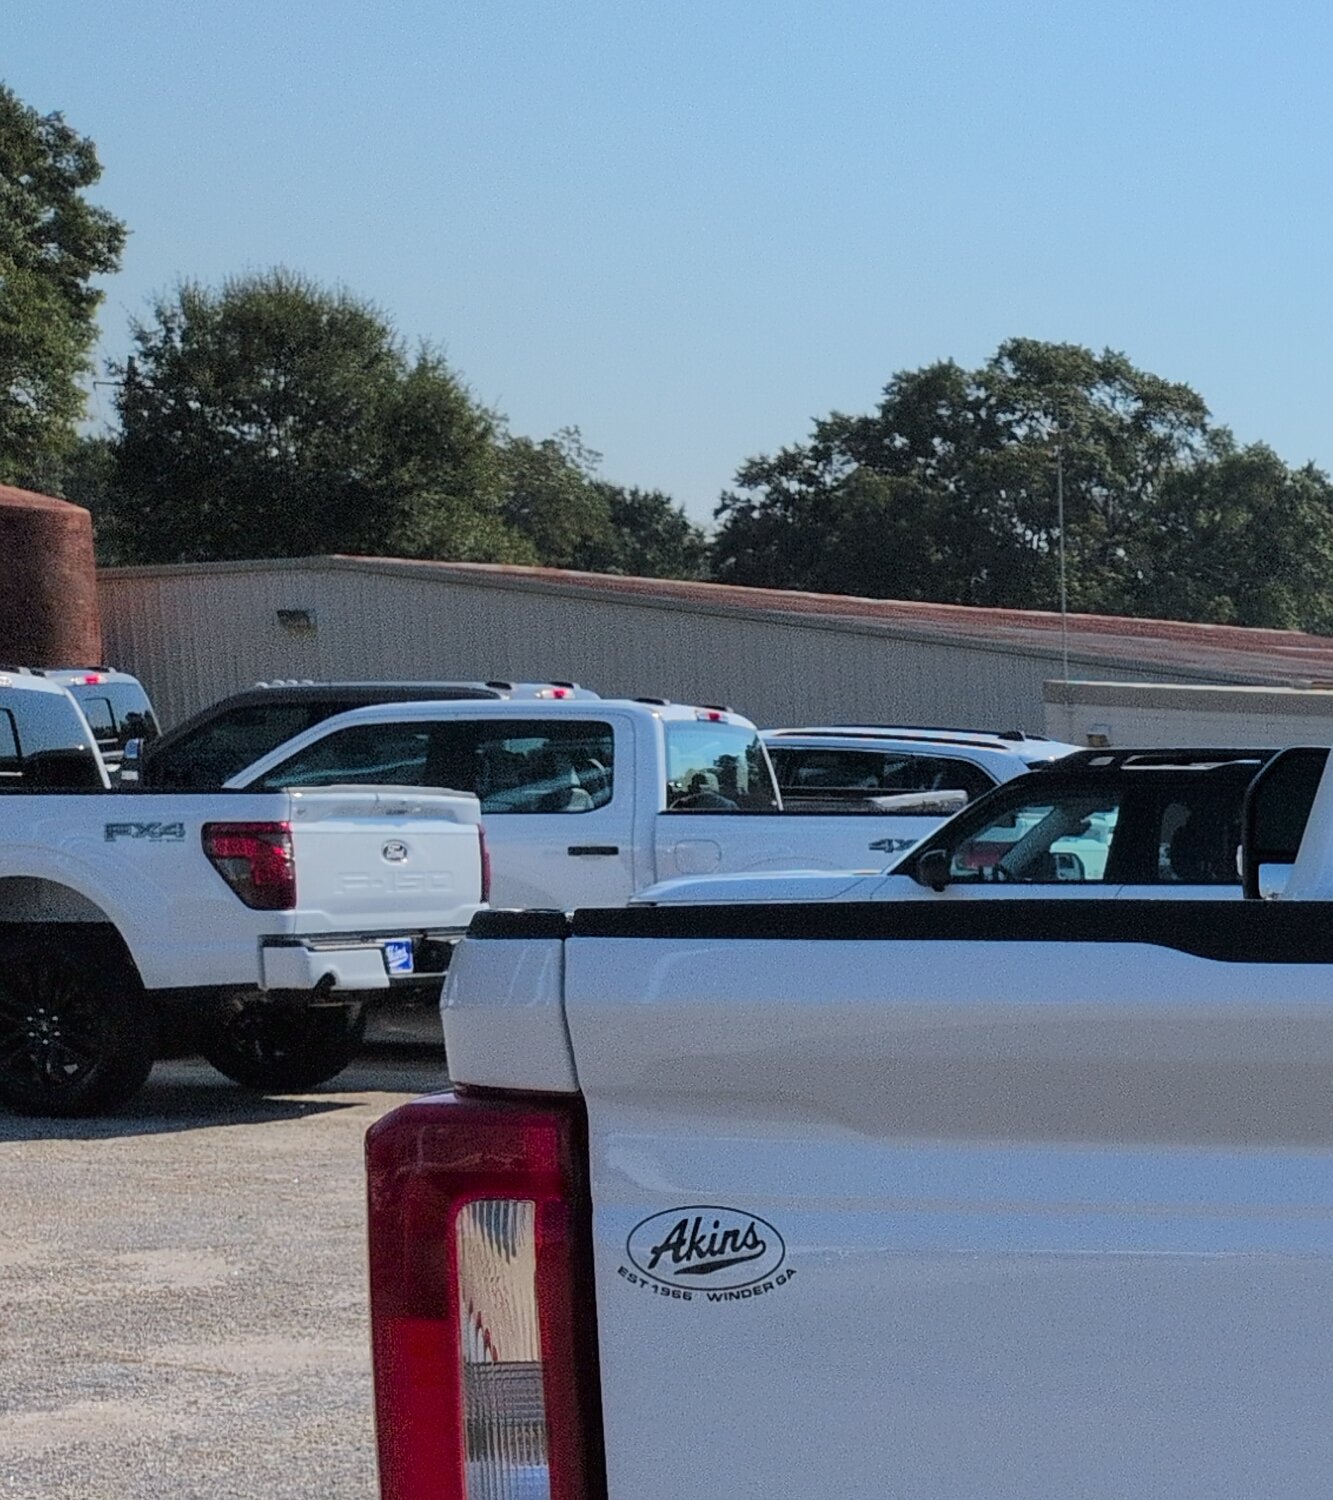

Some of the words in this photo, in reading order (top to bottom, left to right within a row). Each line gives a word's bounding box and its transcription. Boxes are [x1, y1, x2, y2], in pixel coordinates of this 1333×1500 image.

[104, 822, 186, 842] FX4
[648, 1216, 767, 1275] Akins
[617, 1266, 648, 1287] EST
[652, 1284, 693, 1301] 1966
[706, 1281, 775, 1302] WINDER
[776, 1267, 797, 1286] GA
